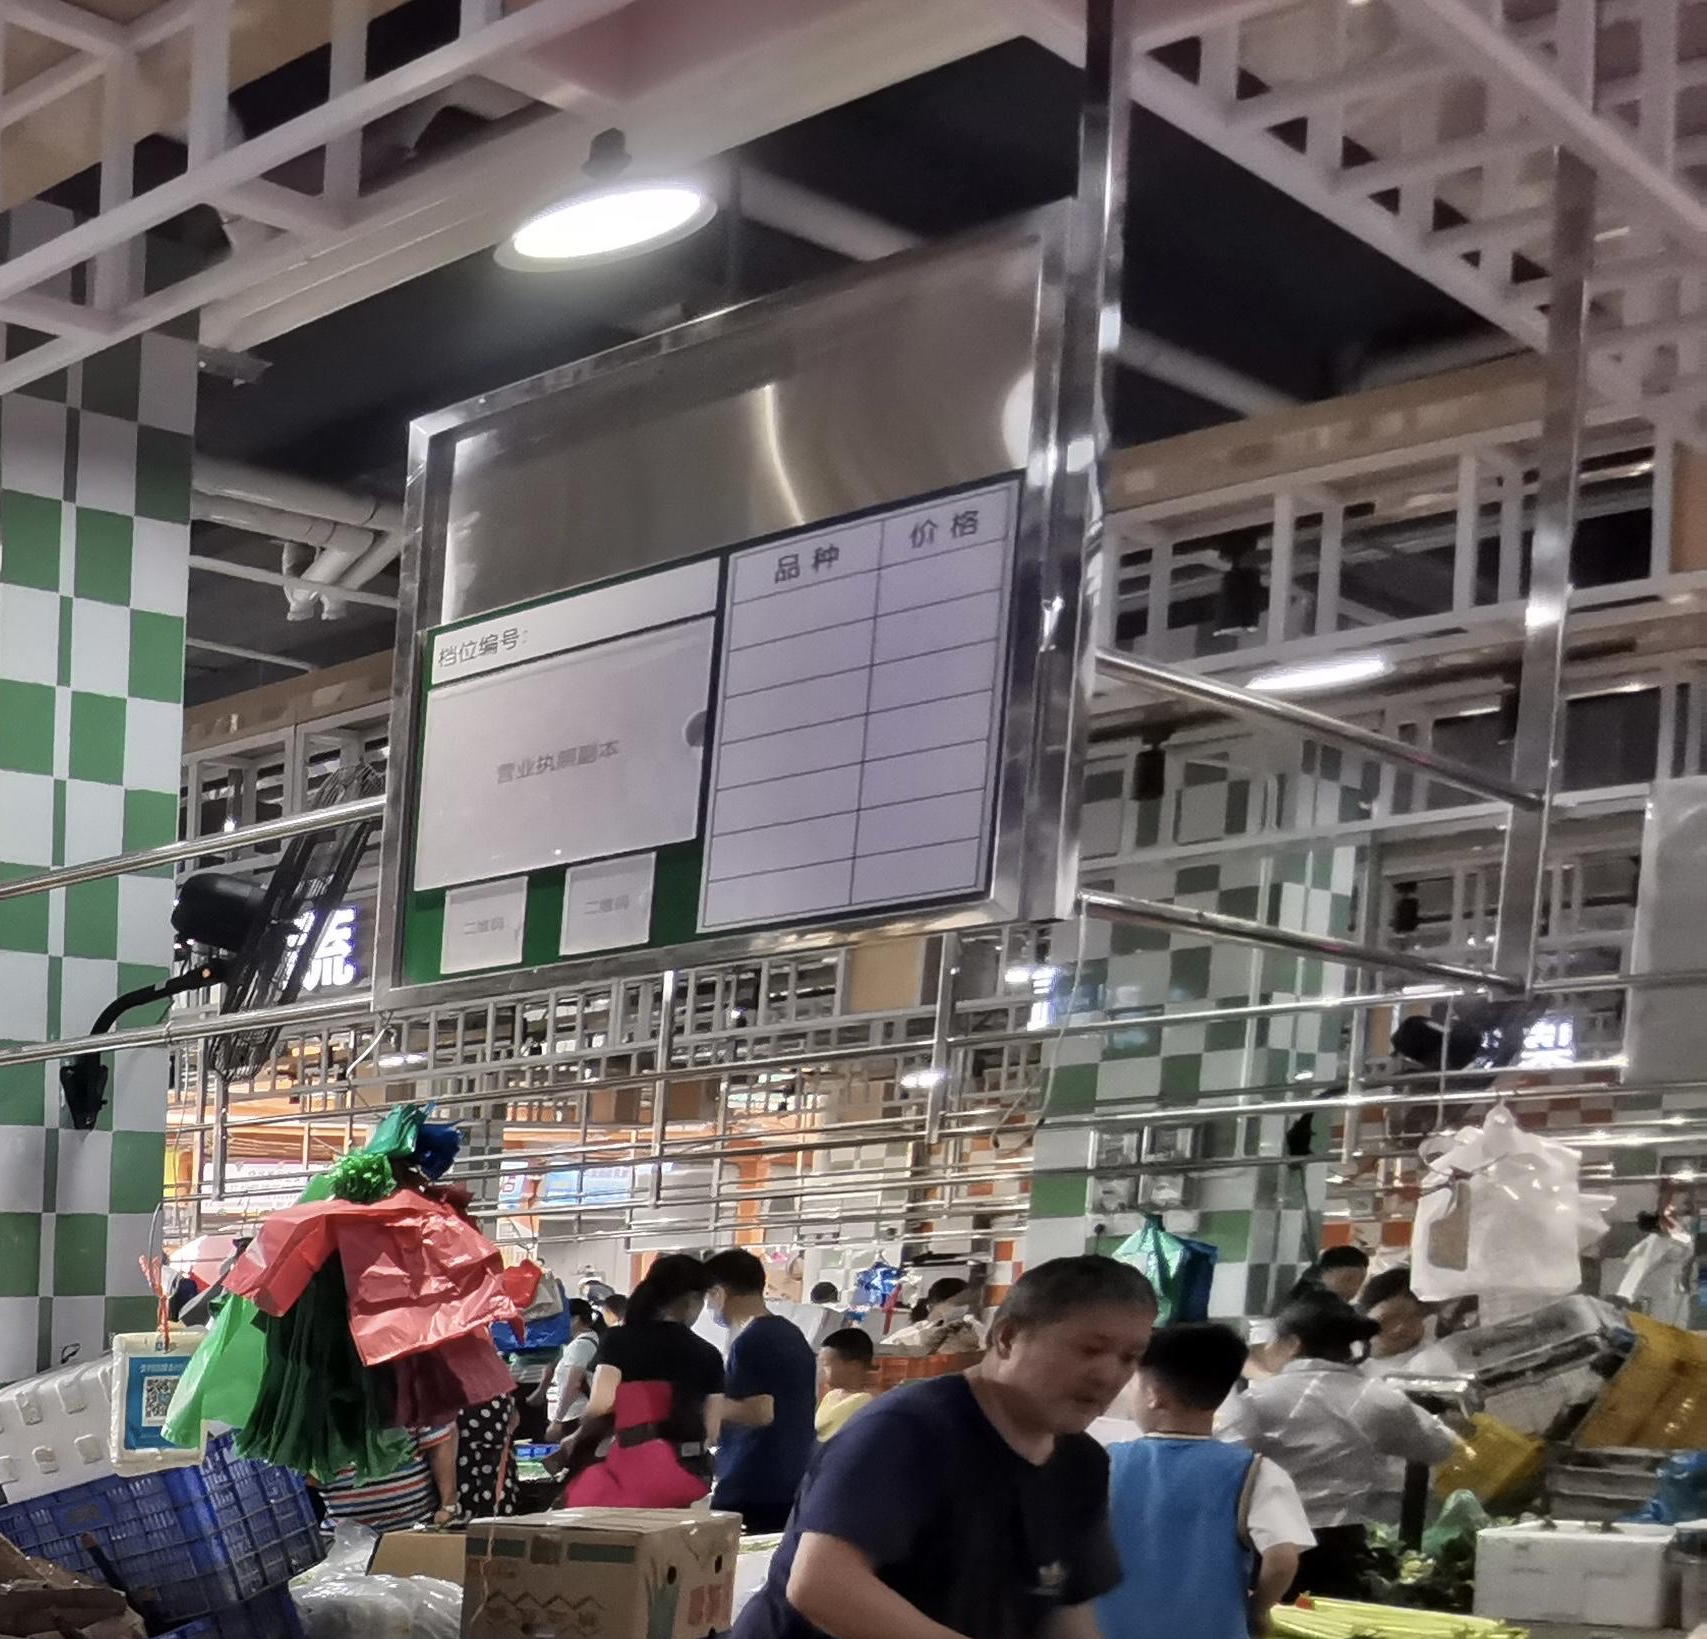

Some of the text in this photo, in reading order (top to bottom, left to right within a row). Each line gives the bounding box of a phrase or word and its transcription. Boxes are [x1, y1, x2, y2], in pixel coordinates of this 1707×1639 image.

[774, 509, 981, 584] 品种 价格
[495, 738, 621, 785] 营业执照副本
